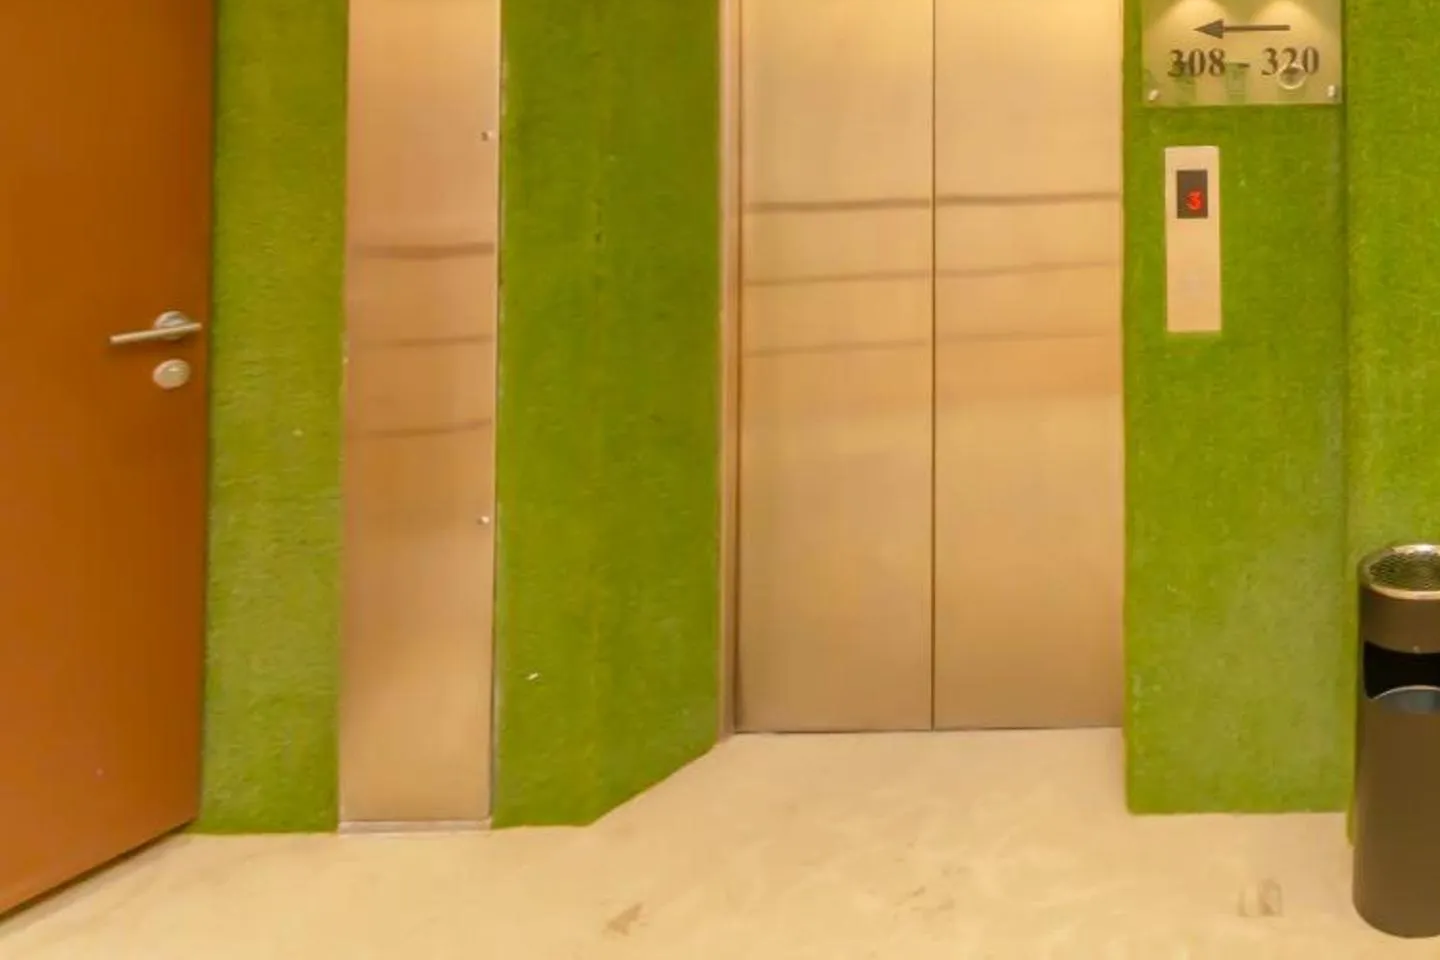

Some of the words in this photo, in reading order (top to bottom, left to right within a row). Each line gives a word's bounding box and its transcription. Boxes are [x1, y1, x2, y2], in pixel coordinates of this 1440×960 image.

[1167, 48, 1226, 77] 308
[1260, 46, 1320, 76] 320
[1187, 191, 1204, 210] 3
